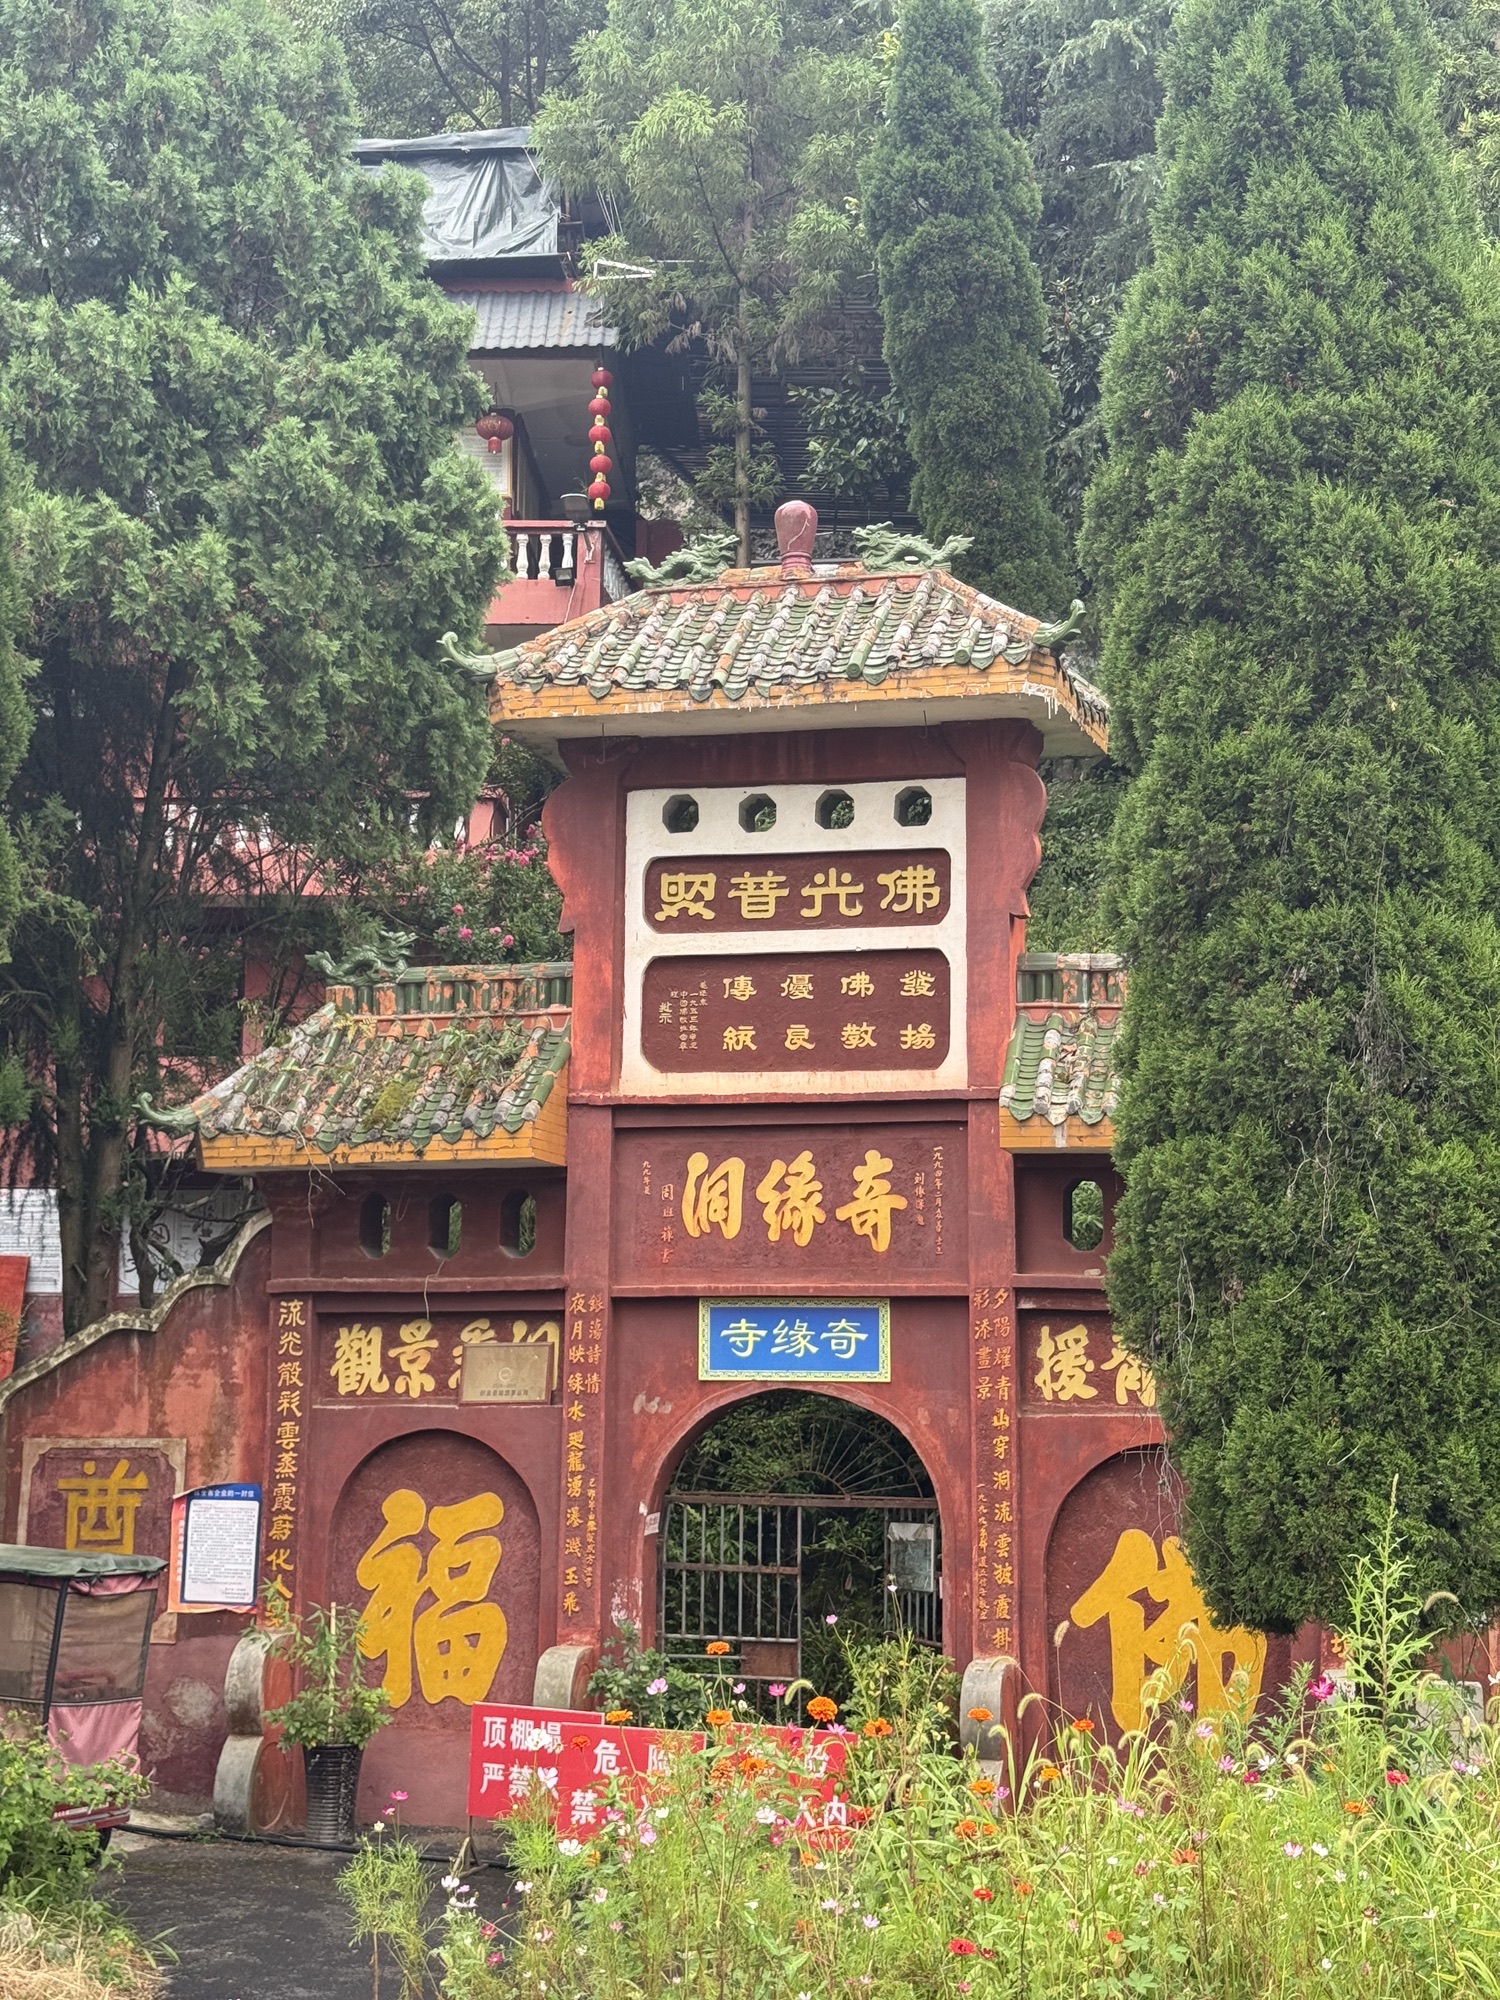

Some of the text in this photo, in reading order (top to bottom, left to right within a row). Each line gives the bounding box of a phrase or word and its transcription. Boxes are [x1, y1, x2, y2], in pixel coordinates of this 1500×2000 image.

[329, 1318, 560, 1399] 景觀
[720, 1318, 869, 1360] 奇缘寺
[356, 1488, 509, 1708] 福
